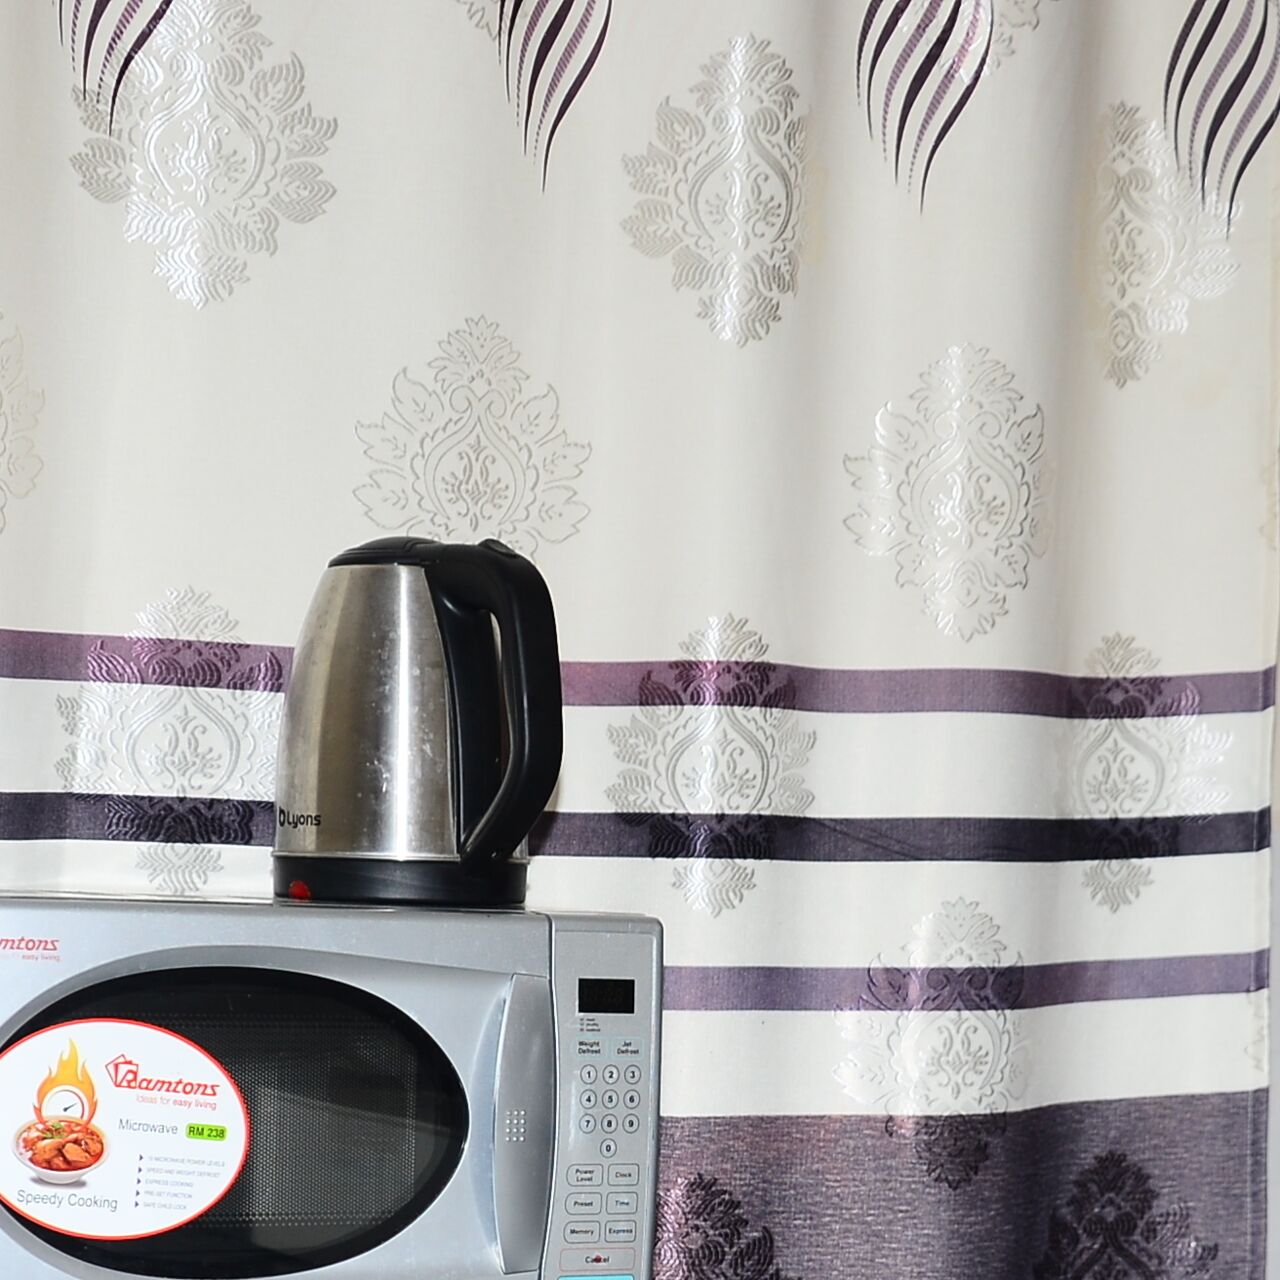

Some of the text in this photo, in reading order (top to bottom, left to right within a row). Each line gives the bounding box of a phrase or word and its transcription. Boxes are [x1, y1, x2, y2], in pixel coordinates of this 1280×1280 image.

[113, 1060, 220, 1097] Ramtons
[172, 1098, 193, 1109] easy
[194, 1100, 217, 1111] living
[118, 1119, 178, 1134] Microwave
[188, 1126, 204, 1136] RM
[16, 1189, 118, 1212] Speedy Cooking
[570, 1228, 594, 1236] Memory
[608, 1227, 633, 1236] Express
[585, 1256, 610, 1264] Cael
